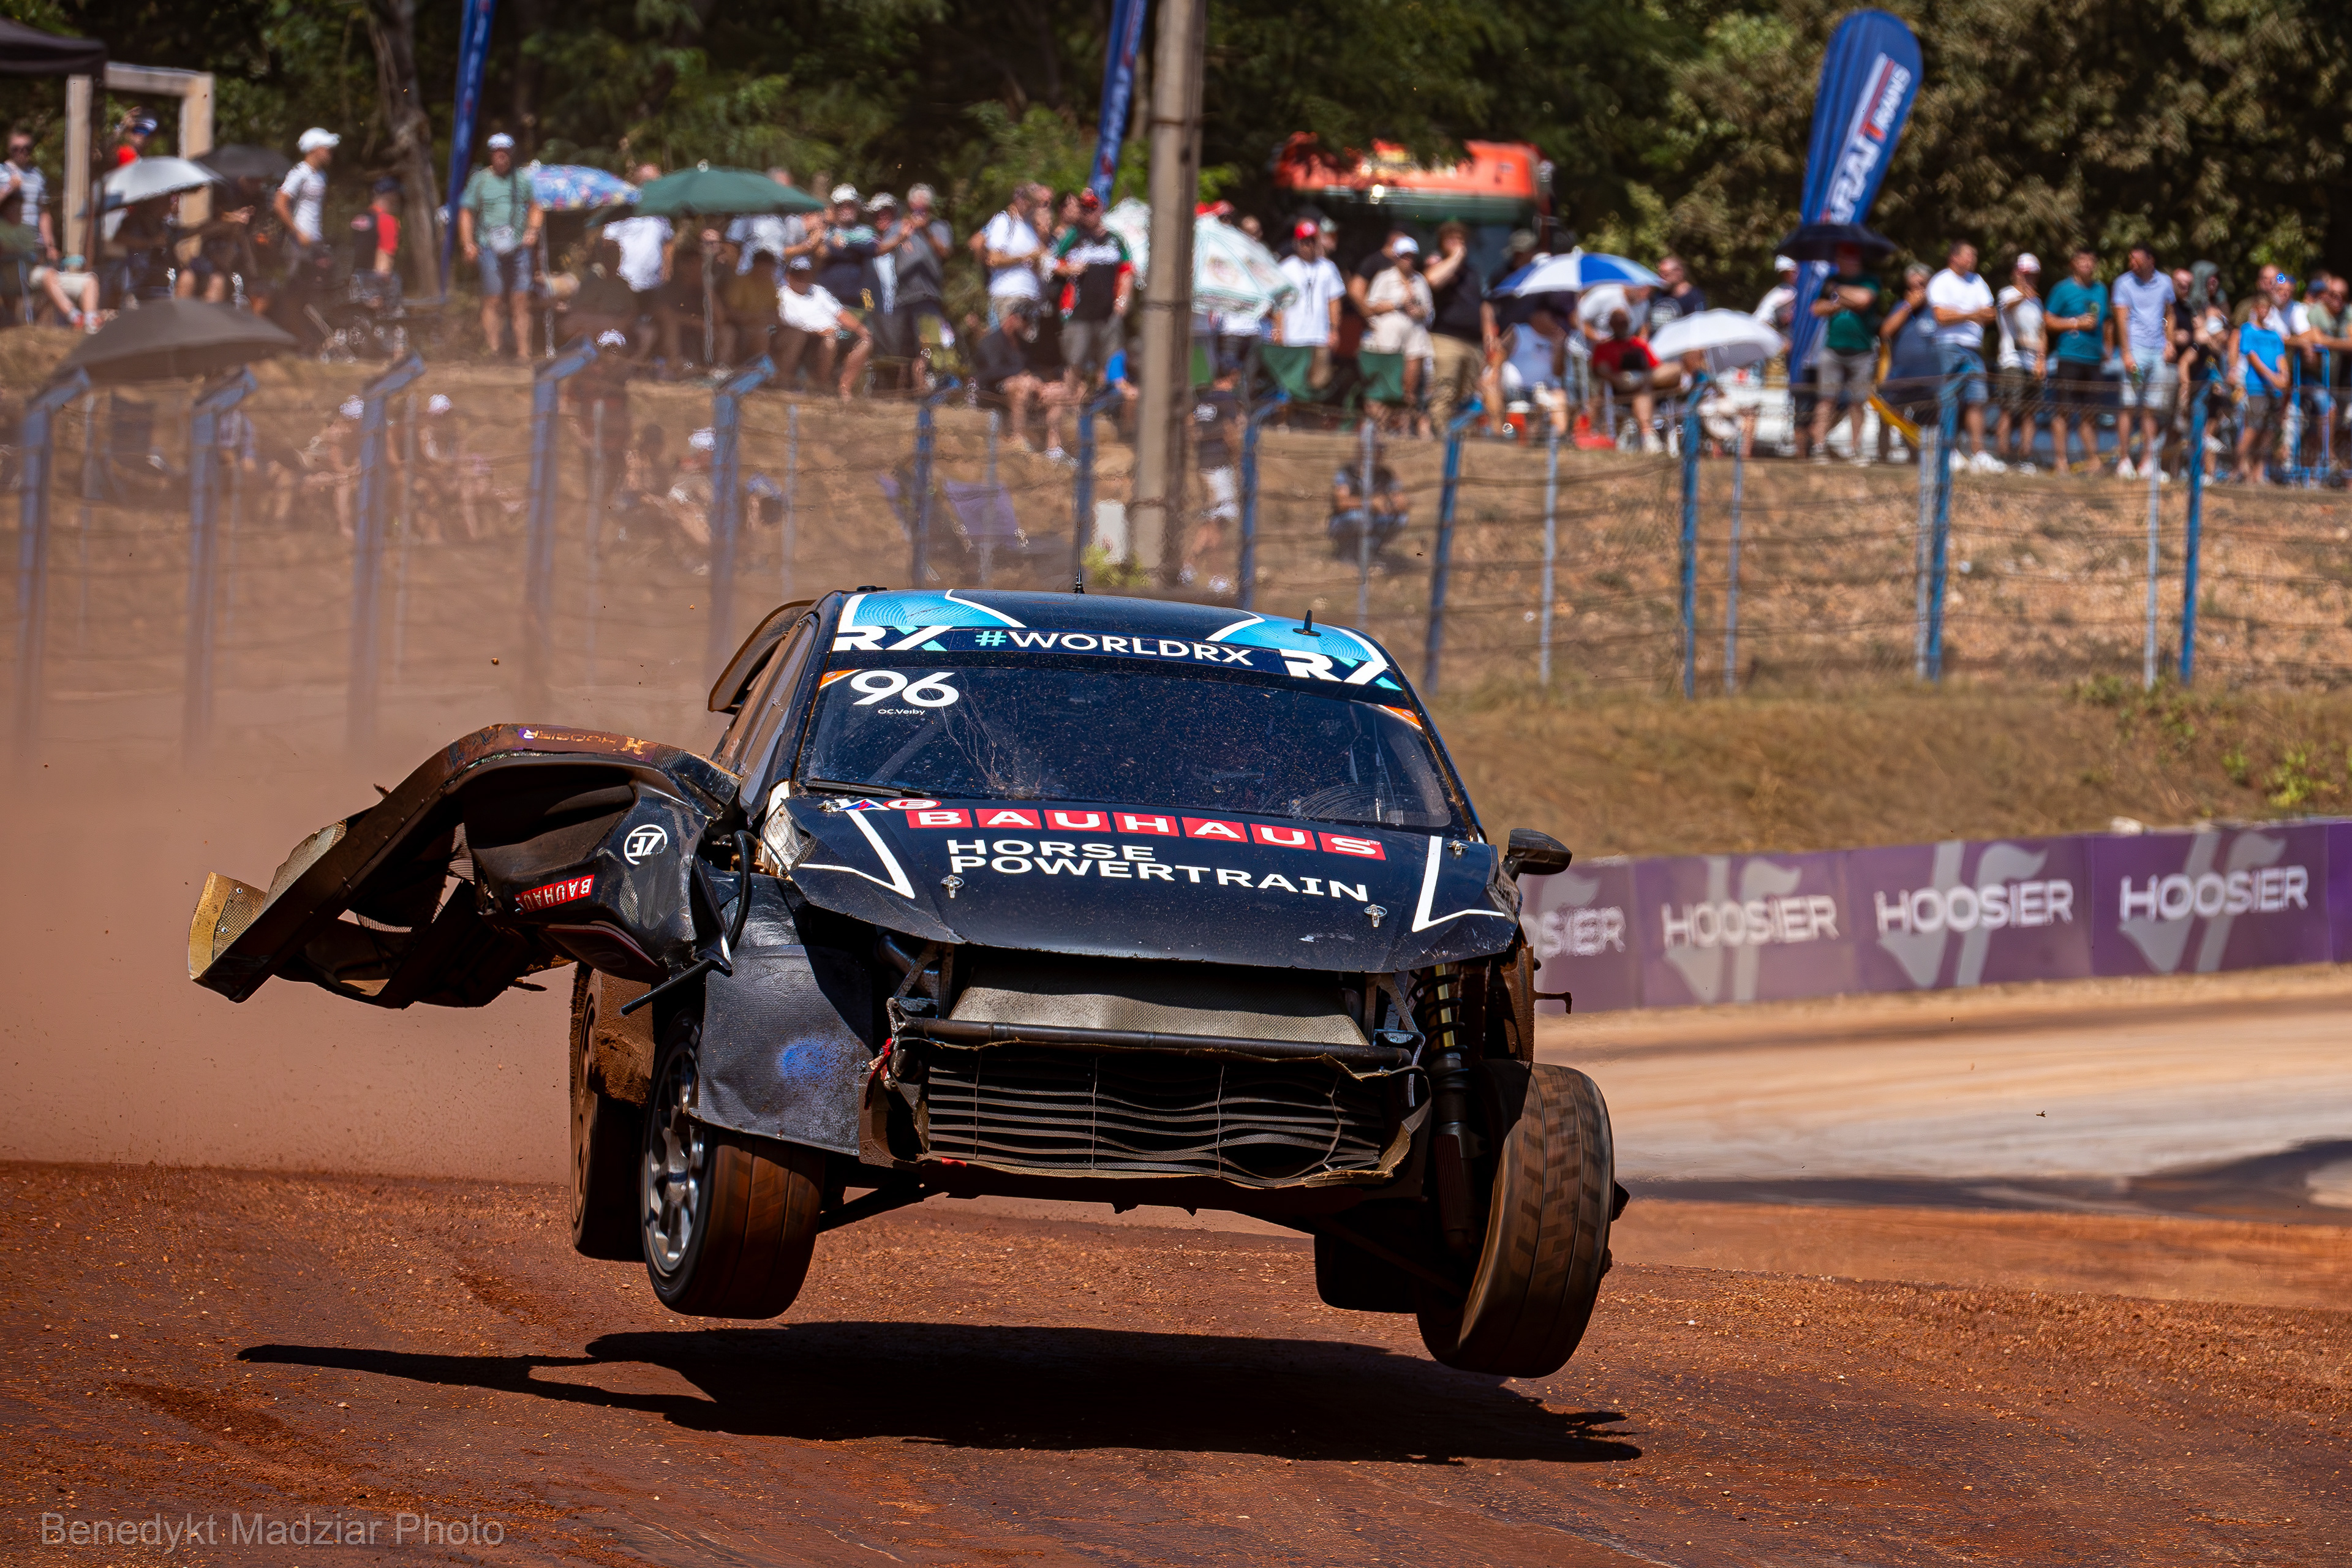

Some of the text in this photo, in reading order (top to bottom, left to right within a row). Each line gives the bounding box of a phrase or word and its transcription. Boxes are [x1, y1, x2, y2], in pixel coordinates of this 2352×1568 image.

[975, 630, 1254, 666] #WORLDRX
[850, 669, 960, 707] 96
[625, 830, 666, 859] ZF
[918, 810, 1376, 855] BAUHAUS
[947, 839, 1156, 862] HORSE
[949, 855, 1368, 902] POWERTRAIN
[2119, 865, 2309, 922] HOOSIER
[1660, 895, 1839, 949] HOOSIER
[1874, 880, 2074, 935] HOOSIER
